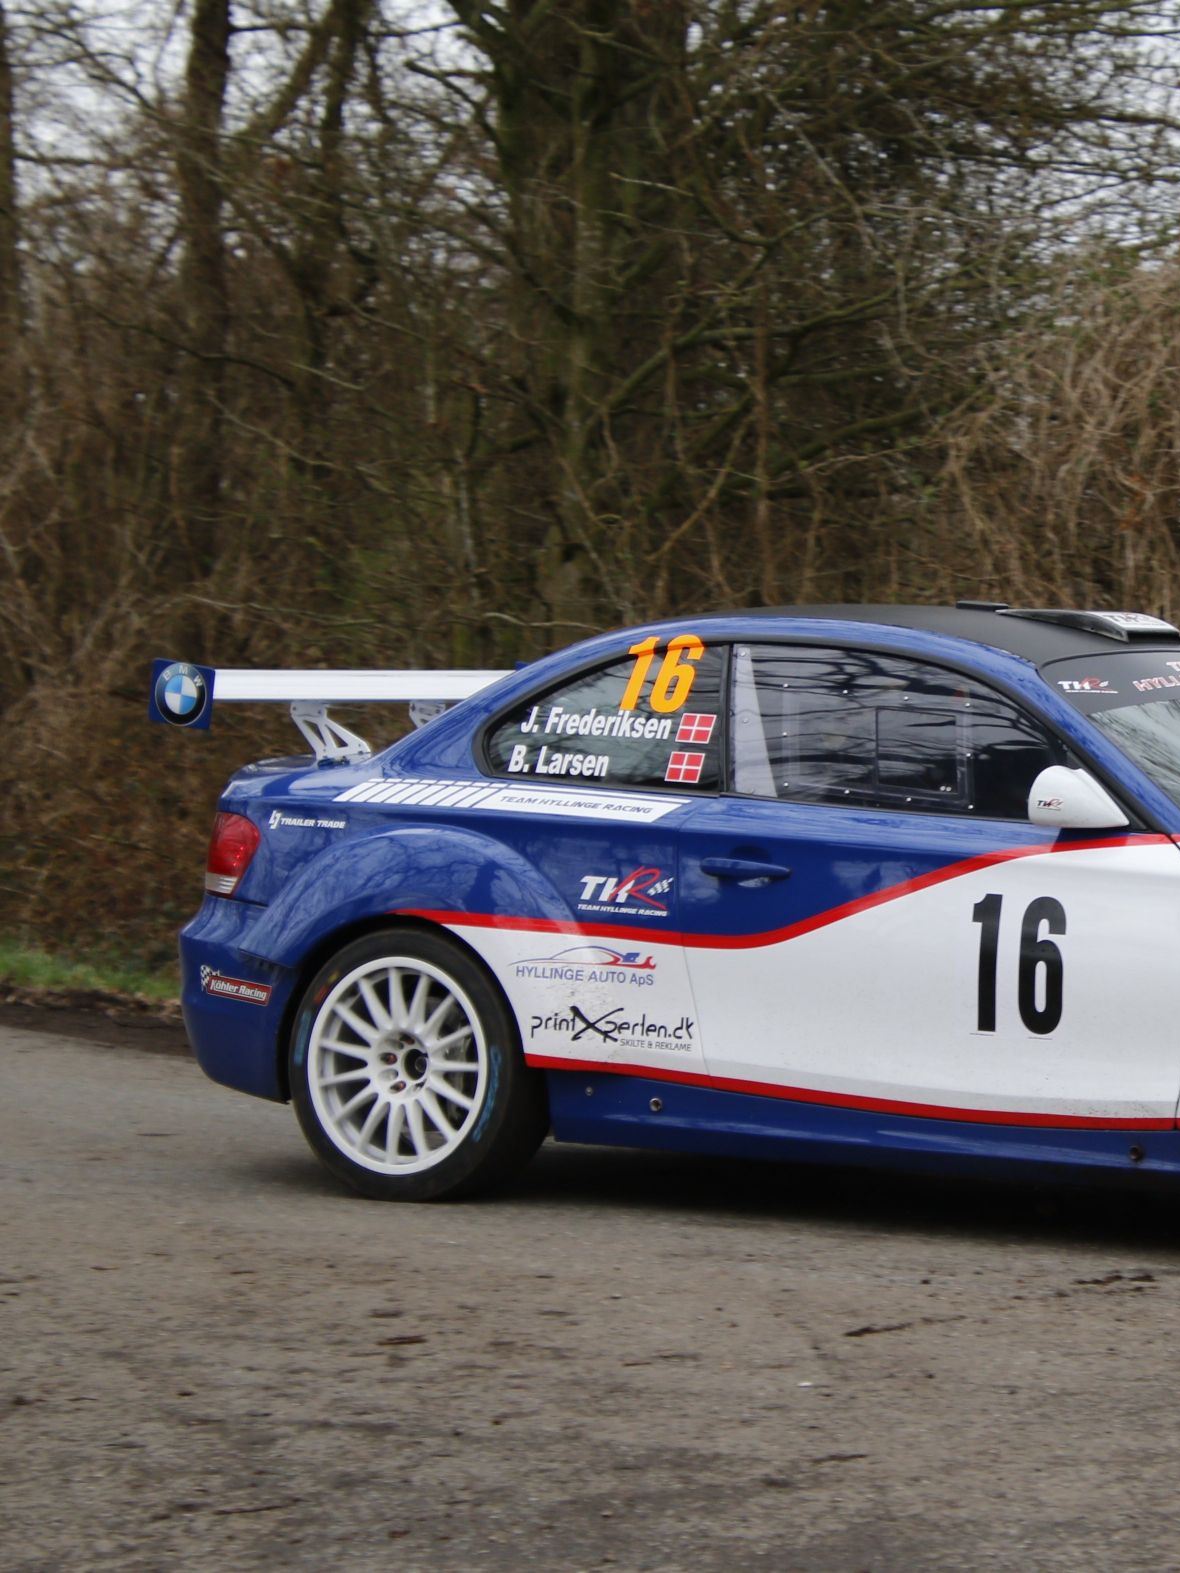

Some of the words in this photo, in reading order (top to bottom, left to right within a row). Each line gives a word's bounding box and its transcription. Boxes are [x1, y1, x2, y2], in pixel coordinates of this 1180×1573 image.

[163, 665, 203, 687] BMW
[620, 634, 705, 713] 16
[520, 706, 539, 734] J.
[545, 706, 673, 740] Frederiksen
[508, 744, 529, 773] B.
[535, 745, 610, 777] Larsen
[501, 795, 537, 804] TEAM
[538, 798, 602, 810] HYLLINGE
[602, 803, 653, 814] RACING
[281, 817, 315, 827] TRAILER
[317, 820, 346, 829] TRADE
[577, 903, 600, 912] TEAM
[600, 905, 638, 915] HYLLINGE
[638, 909, 668, 917] RACING
[972, 893, 1067, 1035] 16
[515, 965, 584, 982] HYLLINGE
[588, 970, 626, 983] AUTO
[629, 973, 654, 987] ApS
[210, 978, 238, 993] Köhler
[239, 985, 267, 1000] Racing
[620, 1038, 645, 1048] SKILTE
[655, 1041, 692, 1051] REKLAME
